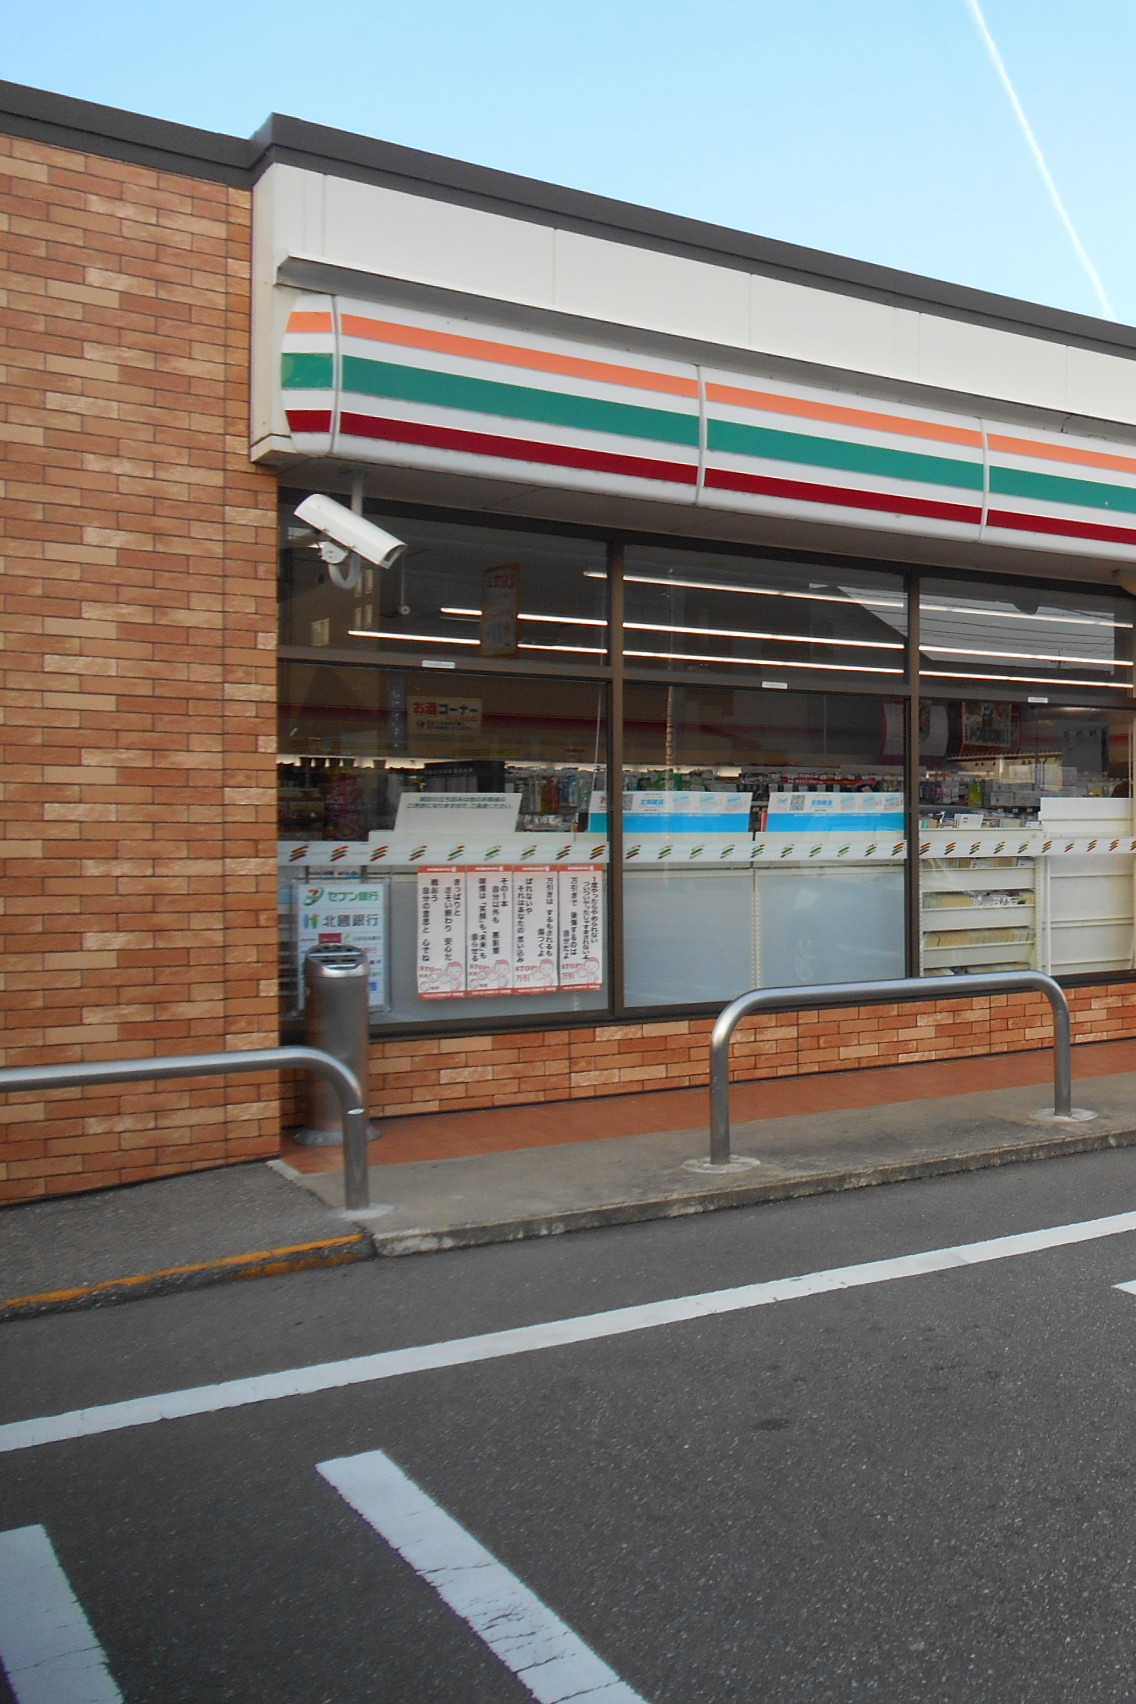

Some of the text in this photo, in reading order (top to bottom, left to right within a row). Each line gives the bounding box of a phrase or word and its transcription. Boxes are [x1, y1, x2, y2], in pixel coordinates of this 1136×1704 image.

[328, 891, 379, 902] セブン銀行
